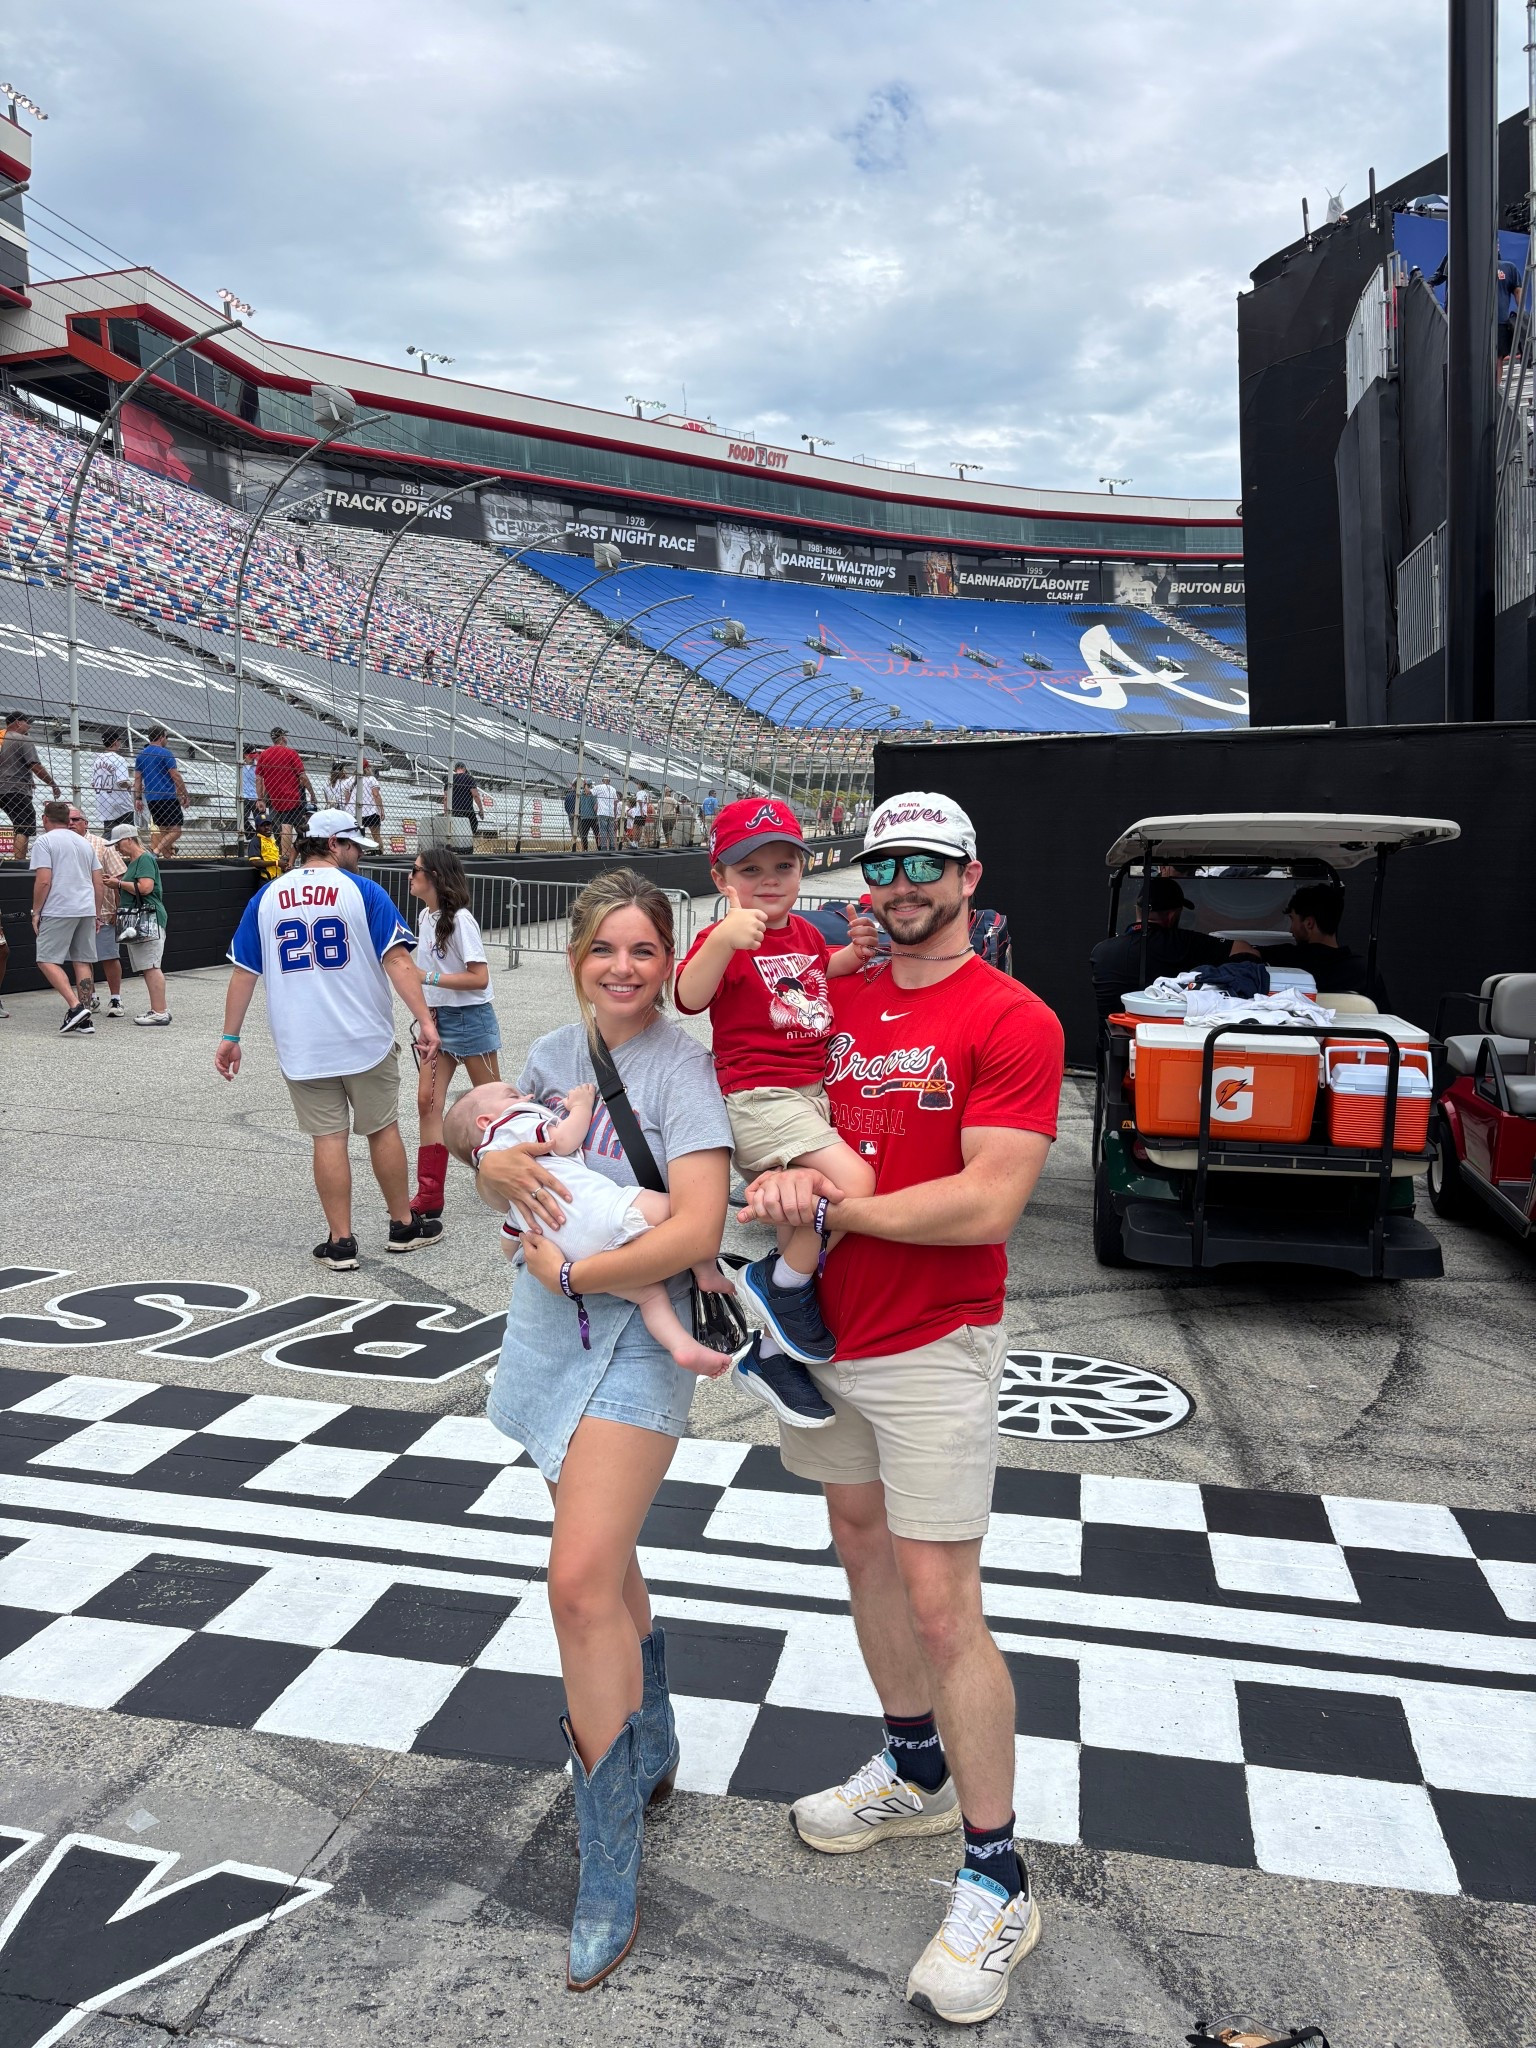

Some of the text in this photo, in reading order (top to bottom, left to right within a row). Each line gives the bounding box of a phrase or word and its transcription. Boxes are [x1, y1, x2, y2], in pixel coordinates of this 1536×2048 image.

[728, 443, 755, 462] FOOD
[767, 451, 789, 468] CITY
[400, 483, 424, 496] 1961
[324, 489, 453, 520] TRACK OPENS
[625, 515, 646, 527] 1978
[565, 521, 696, 552] FIRST NIGHT RACE
[807, 543, 842, 556] 1981-1984
[781, 552, 896, 579] DARRELL WALTRIP'S
[1026, 566, 1044, 575] 1995
[820, 572, 884, 589] 7 WINS IN A ROW
[959, 572, 1090, 591] EARNHARDT/LABONTE
[1170, 582, 1222, 594] BRUTON
[1046, 592, 1084, 601] CLASH #1
[745, 803, 783, 829] A
[873, 808, 948, 838] Braves
[278, 885, 339, 910] OLSON
[274, 915, 351, 974] 28
[824, 1032, 935, 1085] Braves
[1199, 1066, 1255, 1122] G
